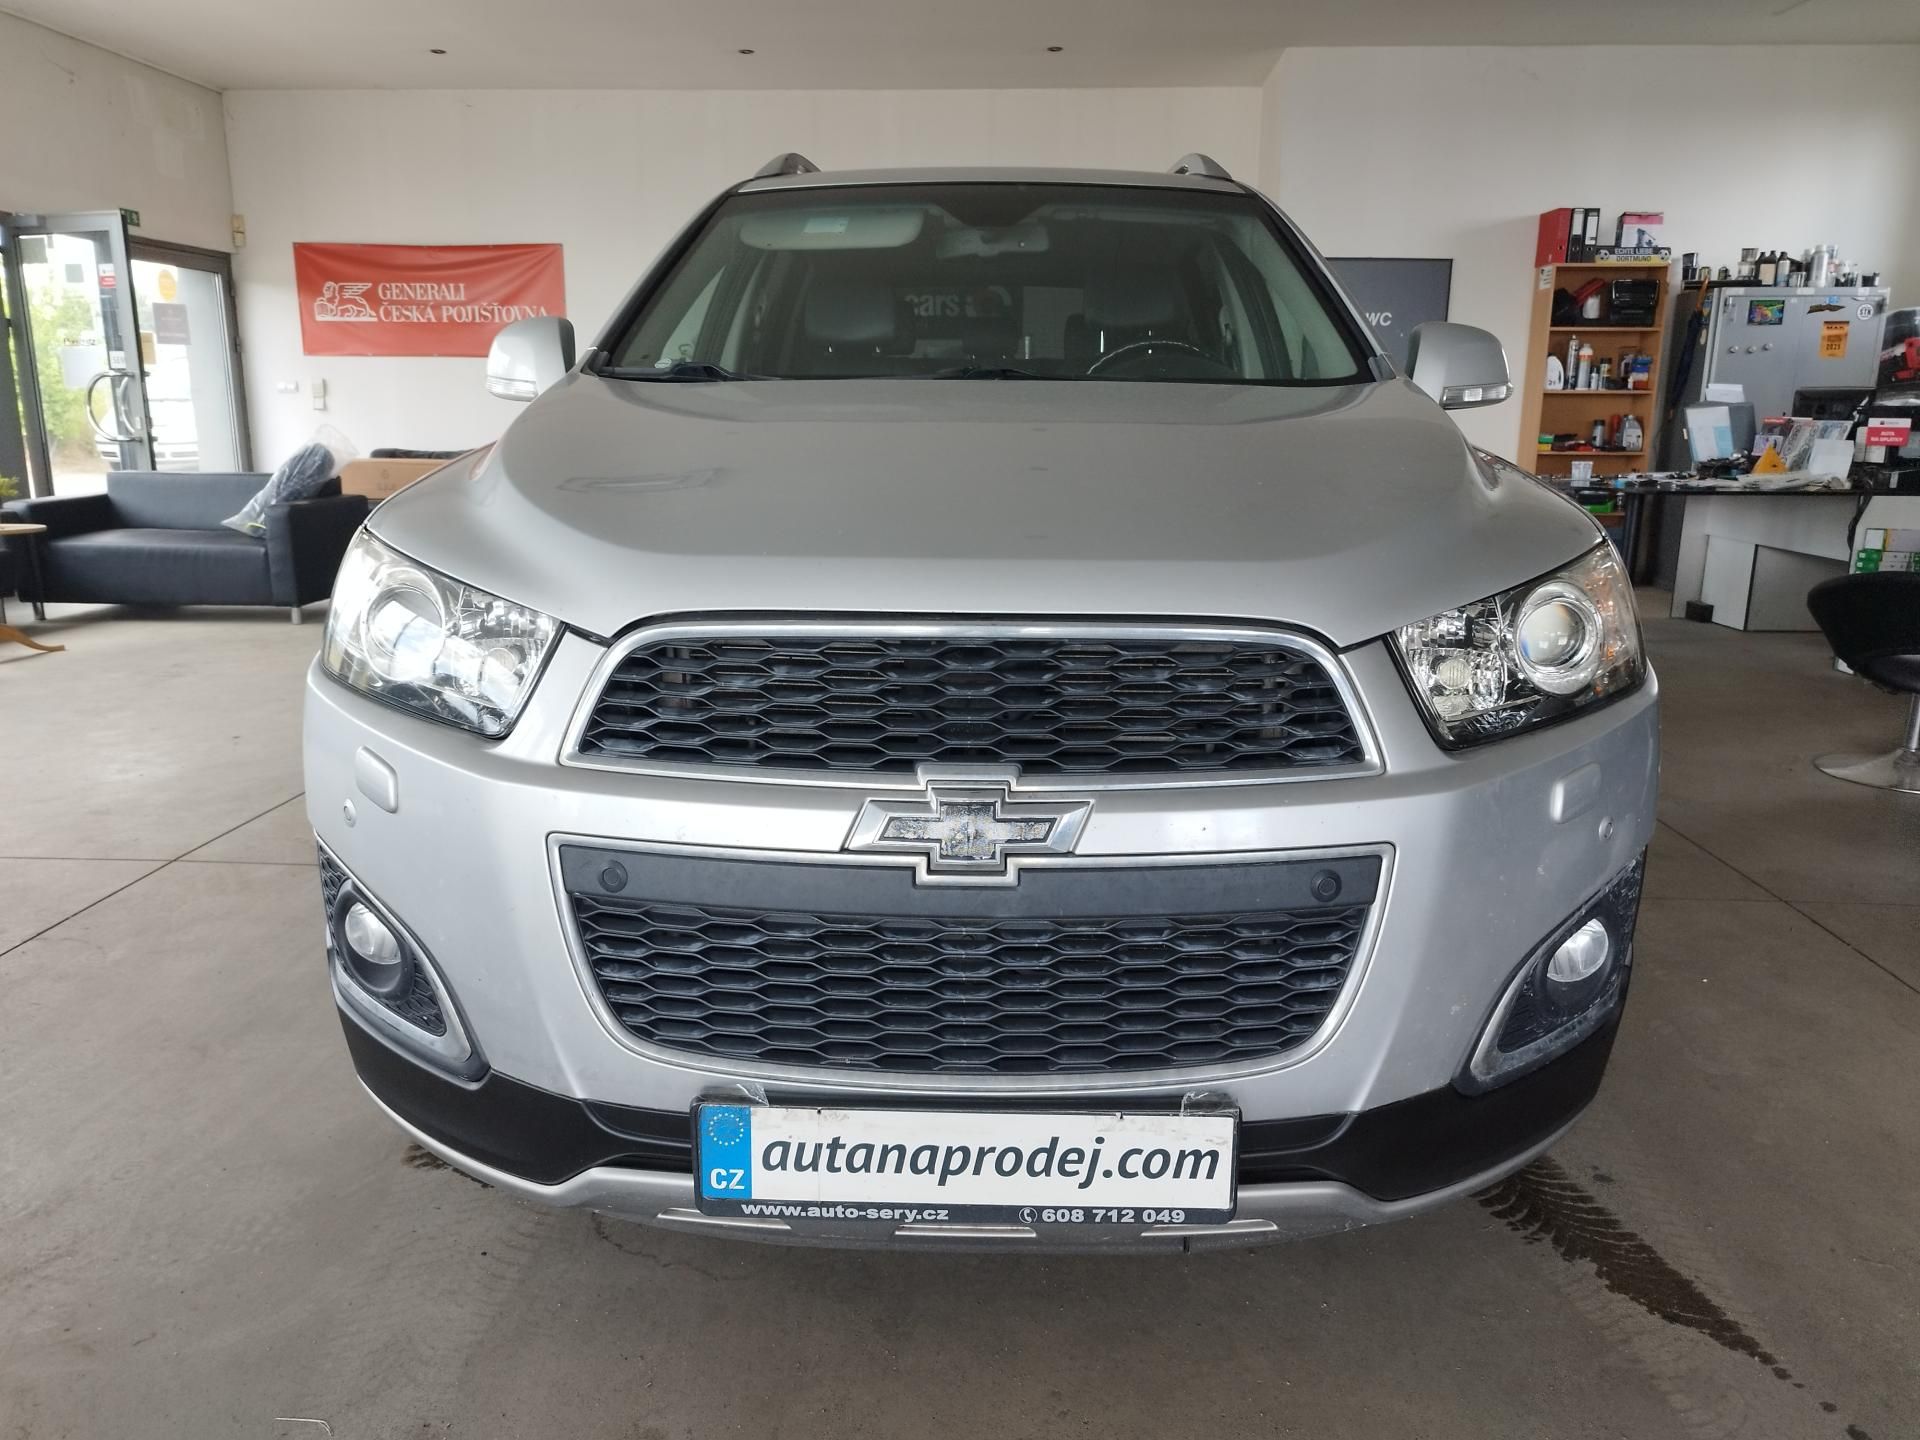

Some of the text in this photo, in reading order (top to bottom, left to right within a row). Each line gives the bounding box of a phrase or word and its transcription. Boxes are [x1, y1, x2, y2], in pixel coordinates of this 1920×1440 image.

[378, 282, 465, 301] GENERALI
[379, 302, 548, 323] ČESKÁ POJIŠŤOVNA
[1366, 312, 1392, 326] WC
[763, 1136, 1219, 1189] autanaprodej.com
[710, 1168, 744, 1190] CZ
[741, 1202, 1186, 1223] www.auto-sery.cz 608 712 049
